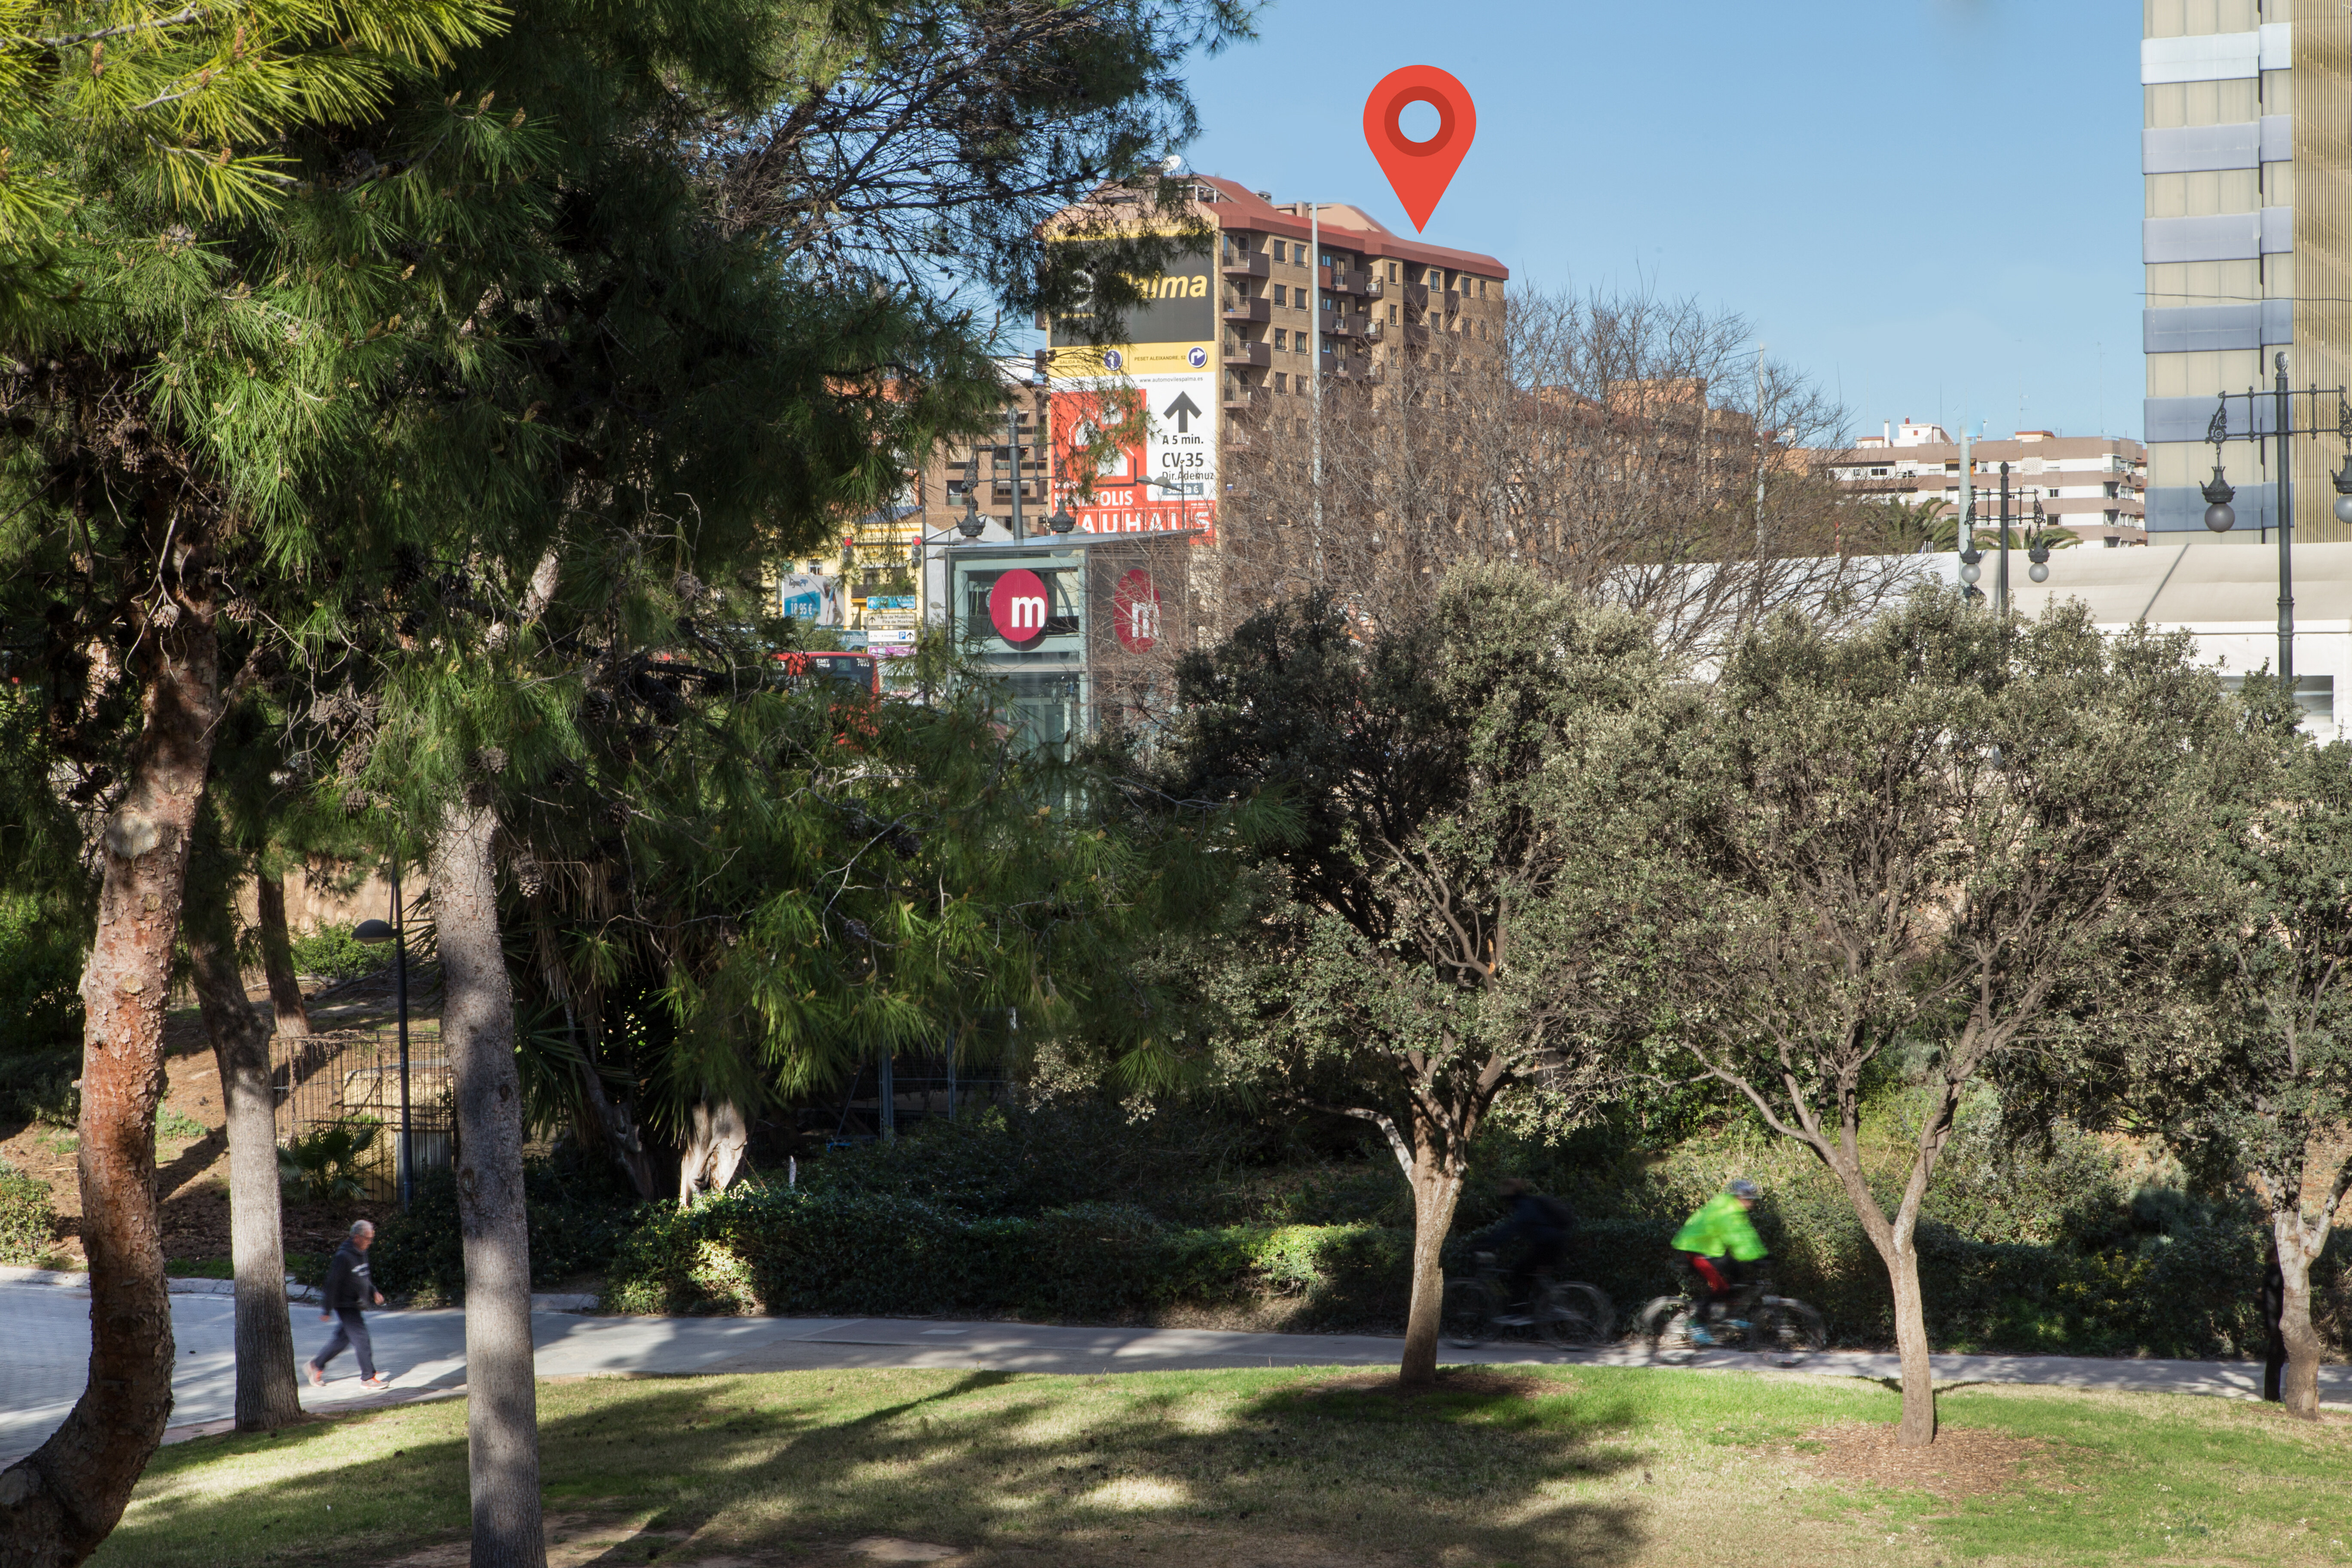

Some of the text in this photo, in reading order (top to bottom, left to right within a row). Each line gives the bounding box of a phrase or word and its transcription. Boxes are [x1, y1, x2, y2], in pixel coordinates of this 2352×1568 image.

[1115, 271, 1207, 299] alma
[1162, 434, 1204, 444] A 5 min.
[1081, 511, 1210, 534] AUHAUS
[808, 603, 812, 615] €
[1011, 597, 1045, 628] m
[1132, 602, 1159, 638] m
